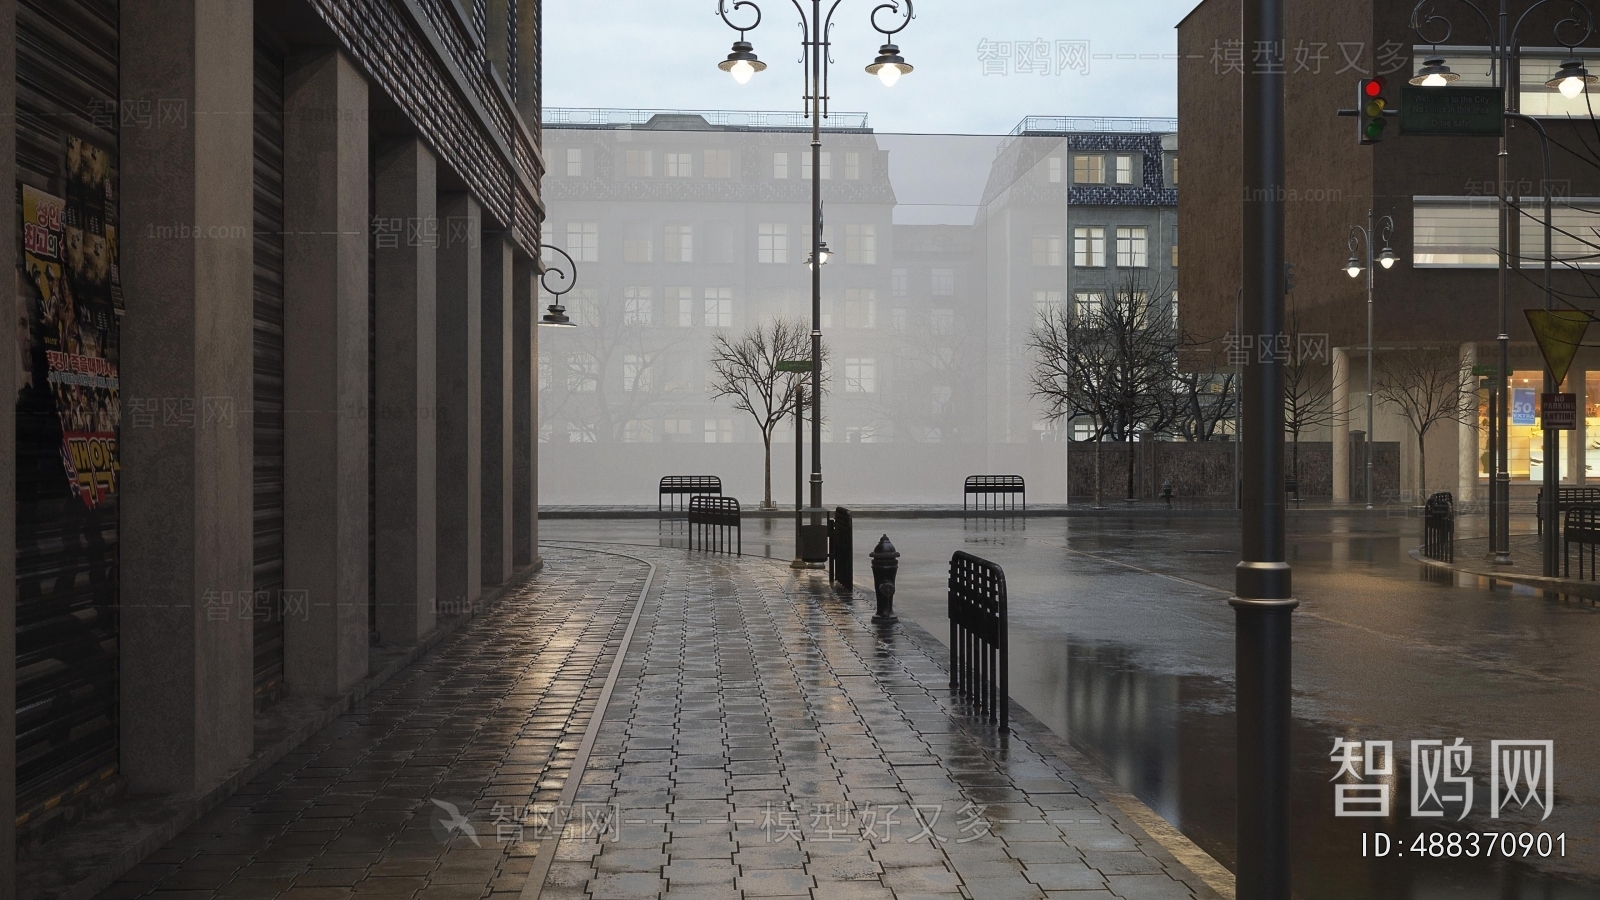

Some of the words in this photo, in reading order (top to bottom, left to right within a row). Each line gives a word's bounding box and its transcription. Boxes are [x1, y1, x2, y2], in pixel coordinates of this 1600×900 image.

[1451, 95, 1459, 103] to
[1461, 95, 1473, 103] the
[1474, 95, 1490, 105] City
[1412, 105, 1423, 113] No
[1448, 105, 1455, 113] in
[1457, 105, 1471, 114] this
[1431, 119, 1452, 127] Drive
[1453, 119, 1472, 127] safe!
[25, 222, 57, 259] 최고의
[1513, 402, 1532, 414] 50
[1543, 402, 1576, 410] PARKING
[1544, 412, 1576, 420] ANYTIME
